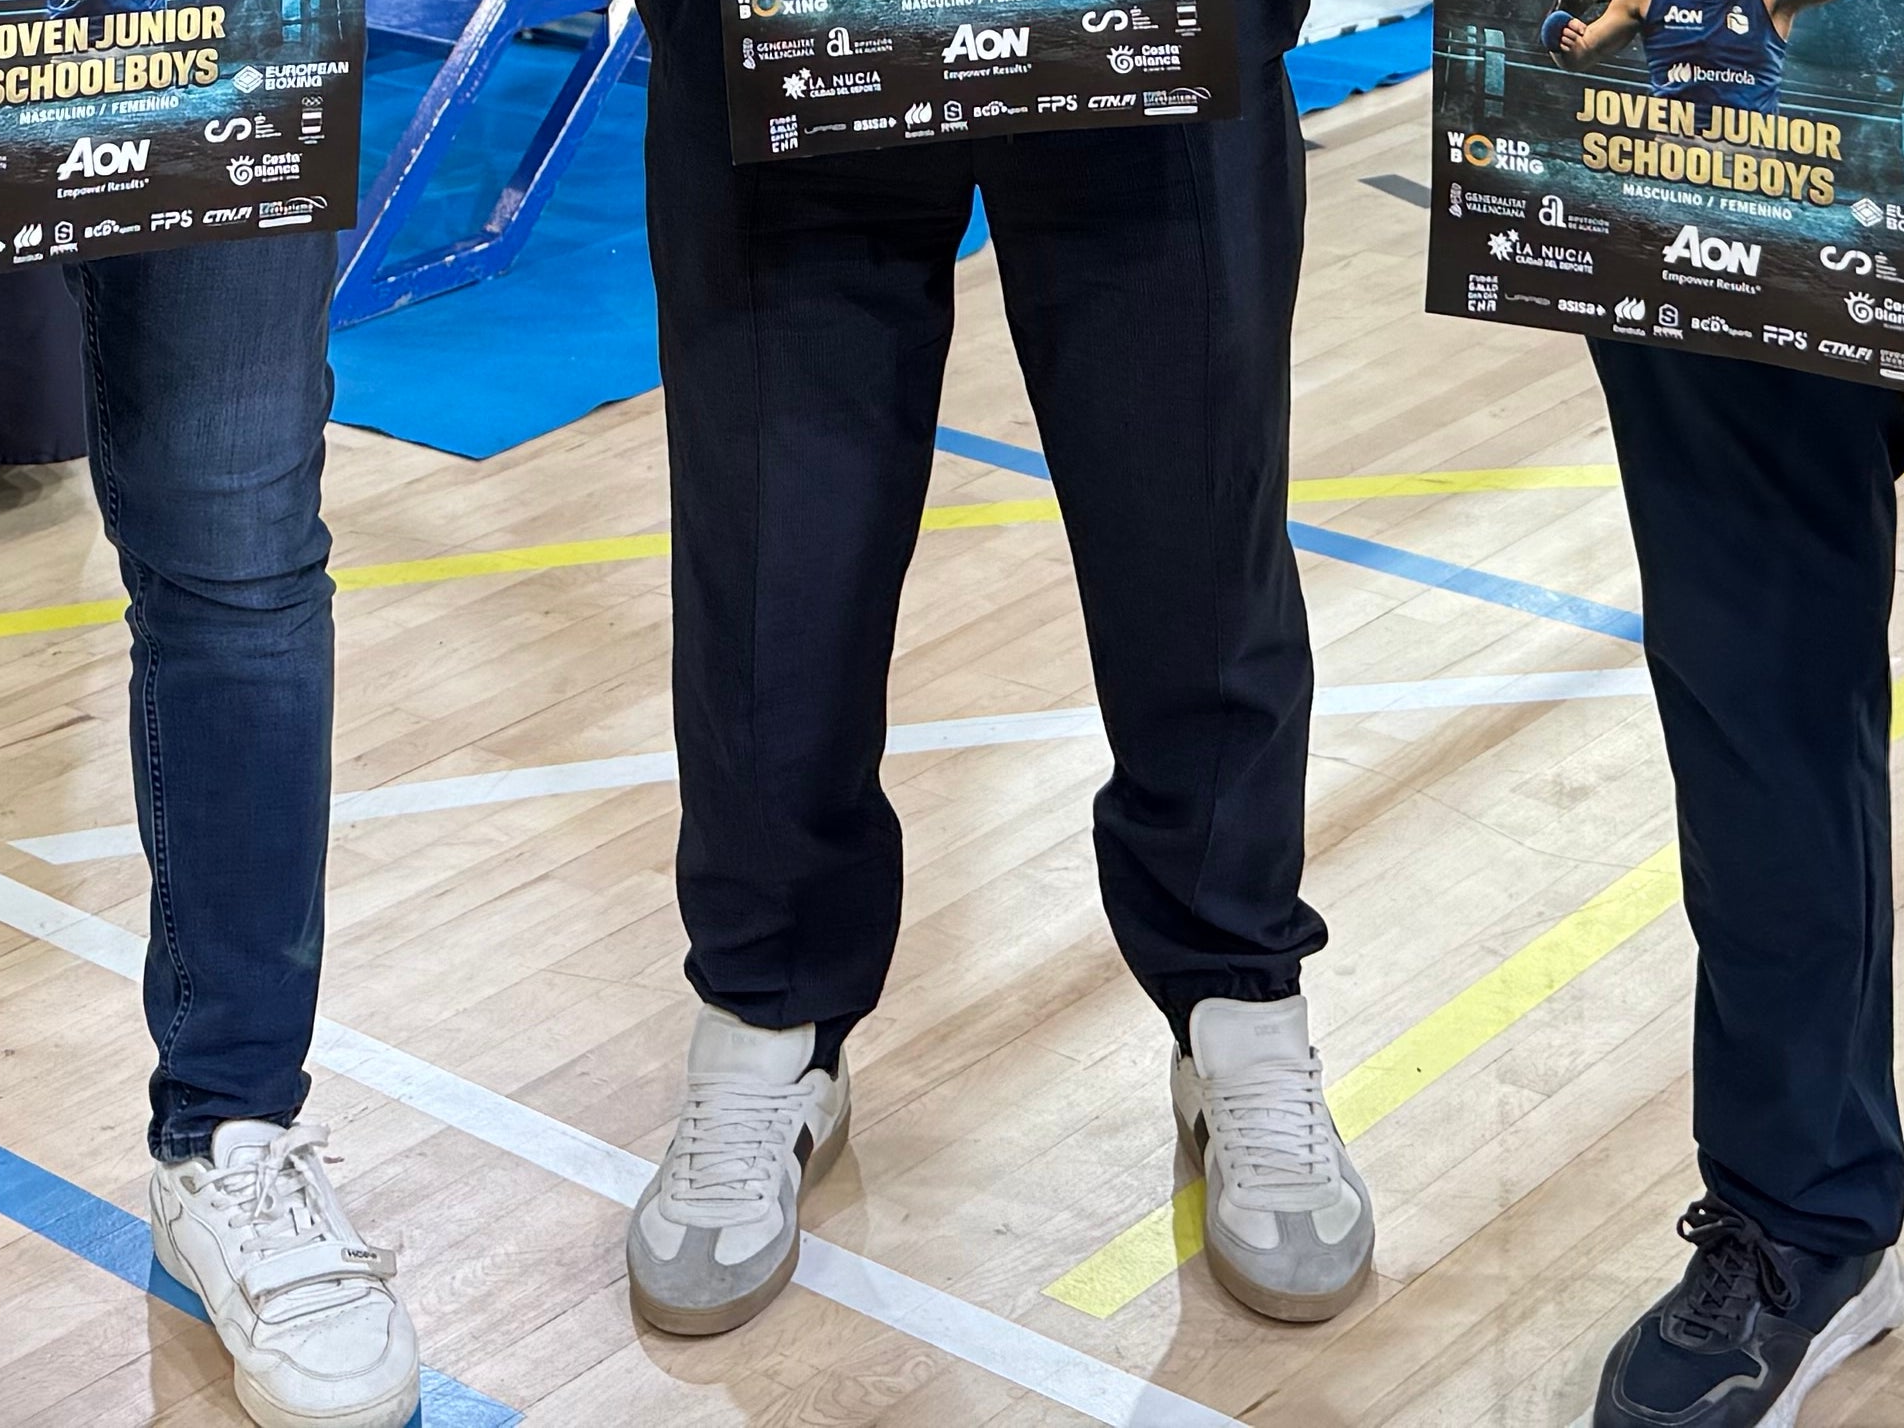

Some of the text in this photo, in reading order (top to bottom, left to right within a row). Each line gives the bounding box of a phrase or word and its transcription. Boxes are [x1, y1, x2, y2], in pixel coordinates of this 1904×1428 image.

[95, 6, 226, 48] JUNIOR
[265, 61, 349, 79] EUROPEAN
[1693, 65, 1755, 86] Iberdrola
[265, 75, 322, 90] BOXING
[809, 75, 825, 90] LA
[20, 95, 179, 125] MASCULINO FEMENINO
[1037, 94, 1077, 114] FPS
[1576, 87, 1842, 161] JOVEN JUNIOR
[1582, 131, 1835, 206] SCHOOLBOYS
[1623, 182, 1793, 221] MASCULINO FEMENINO
[150, 209, 193, 232] FPS
[1515, 242, 1533, 257] LA
[1557, 298, 1595, 315] asisa
[1763, 324, 1808, 352] FPS
